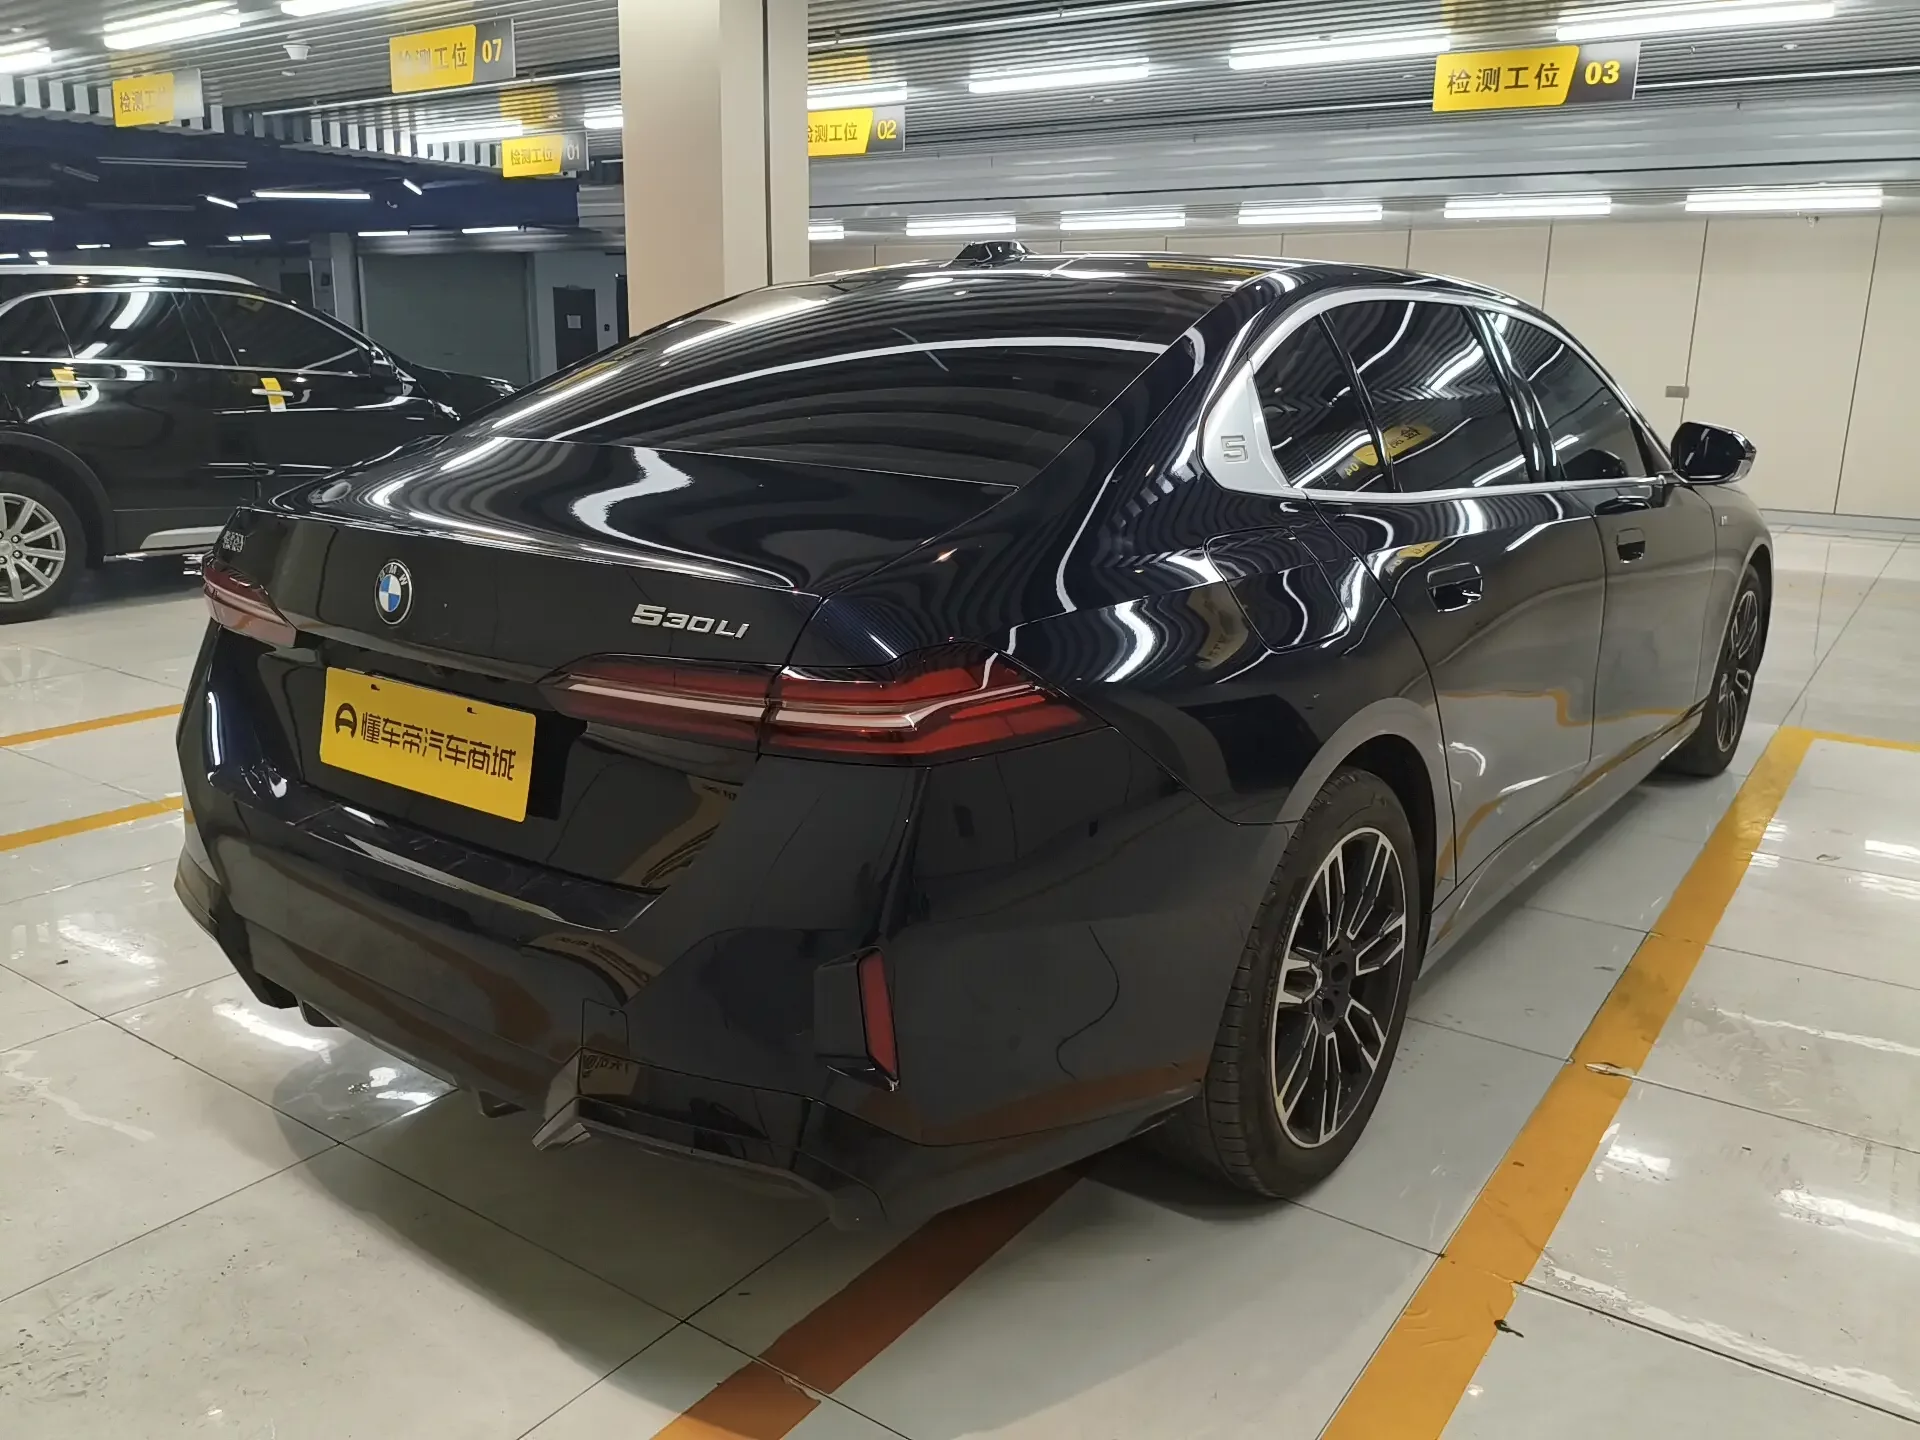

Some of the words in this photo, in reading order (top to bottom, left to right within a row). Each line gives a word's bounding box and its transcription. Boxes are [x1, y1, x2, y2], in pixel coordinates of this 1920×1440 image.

[399, 41, 467, 70] 测工位
[482, 38, 502, 63] 07
[1447, 62, 1560, 95] 检测工位
[1585, 60, 1620, 85] 03
[120, 87, 166, 113] 检测工
[877, 119, 896, 140] 02
[567, 143, 579, 160] 01
[361, 711, 517, 781] 懂车帝汽车商城
